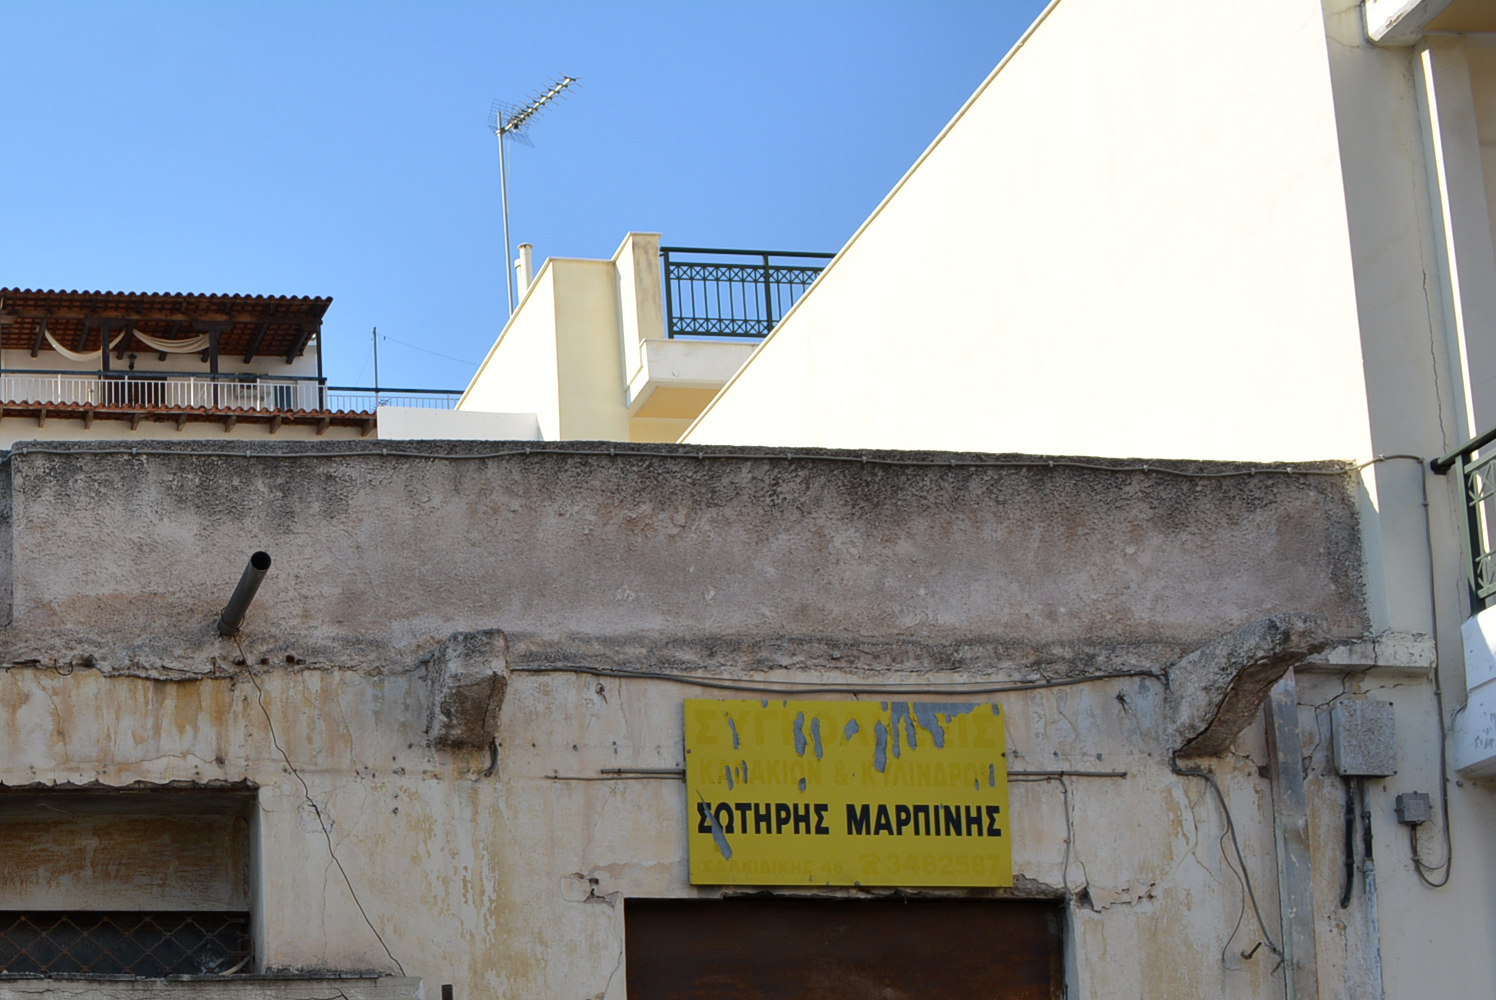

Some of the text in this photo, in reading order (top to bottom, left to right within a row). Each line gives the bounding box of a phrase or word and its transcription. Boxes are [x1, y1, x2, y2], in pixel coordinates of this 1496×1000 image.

[696, 801, 1002, 837] ΣΩΤΗΡΗΣ ΜΑΡΠΙΝΗΣ
[886, 853, 1001, 876] 3462587
